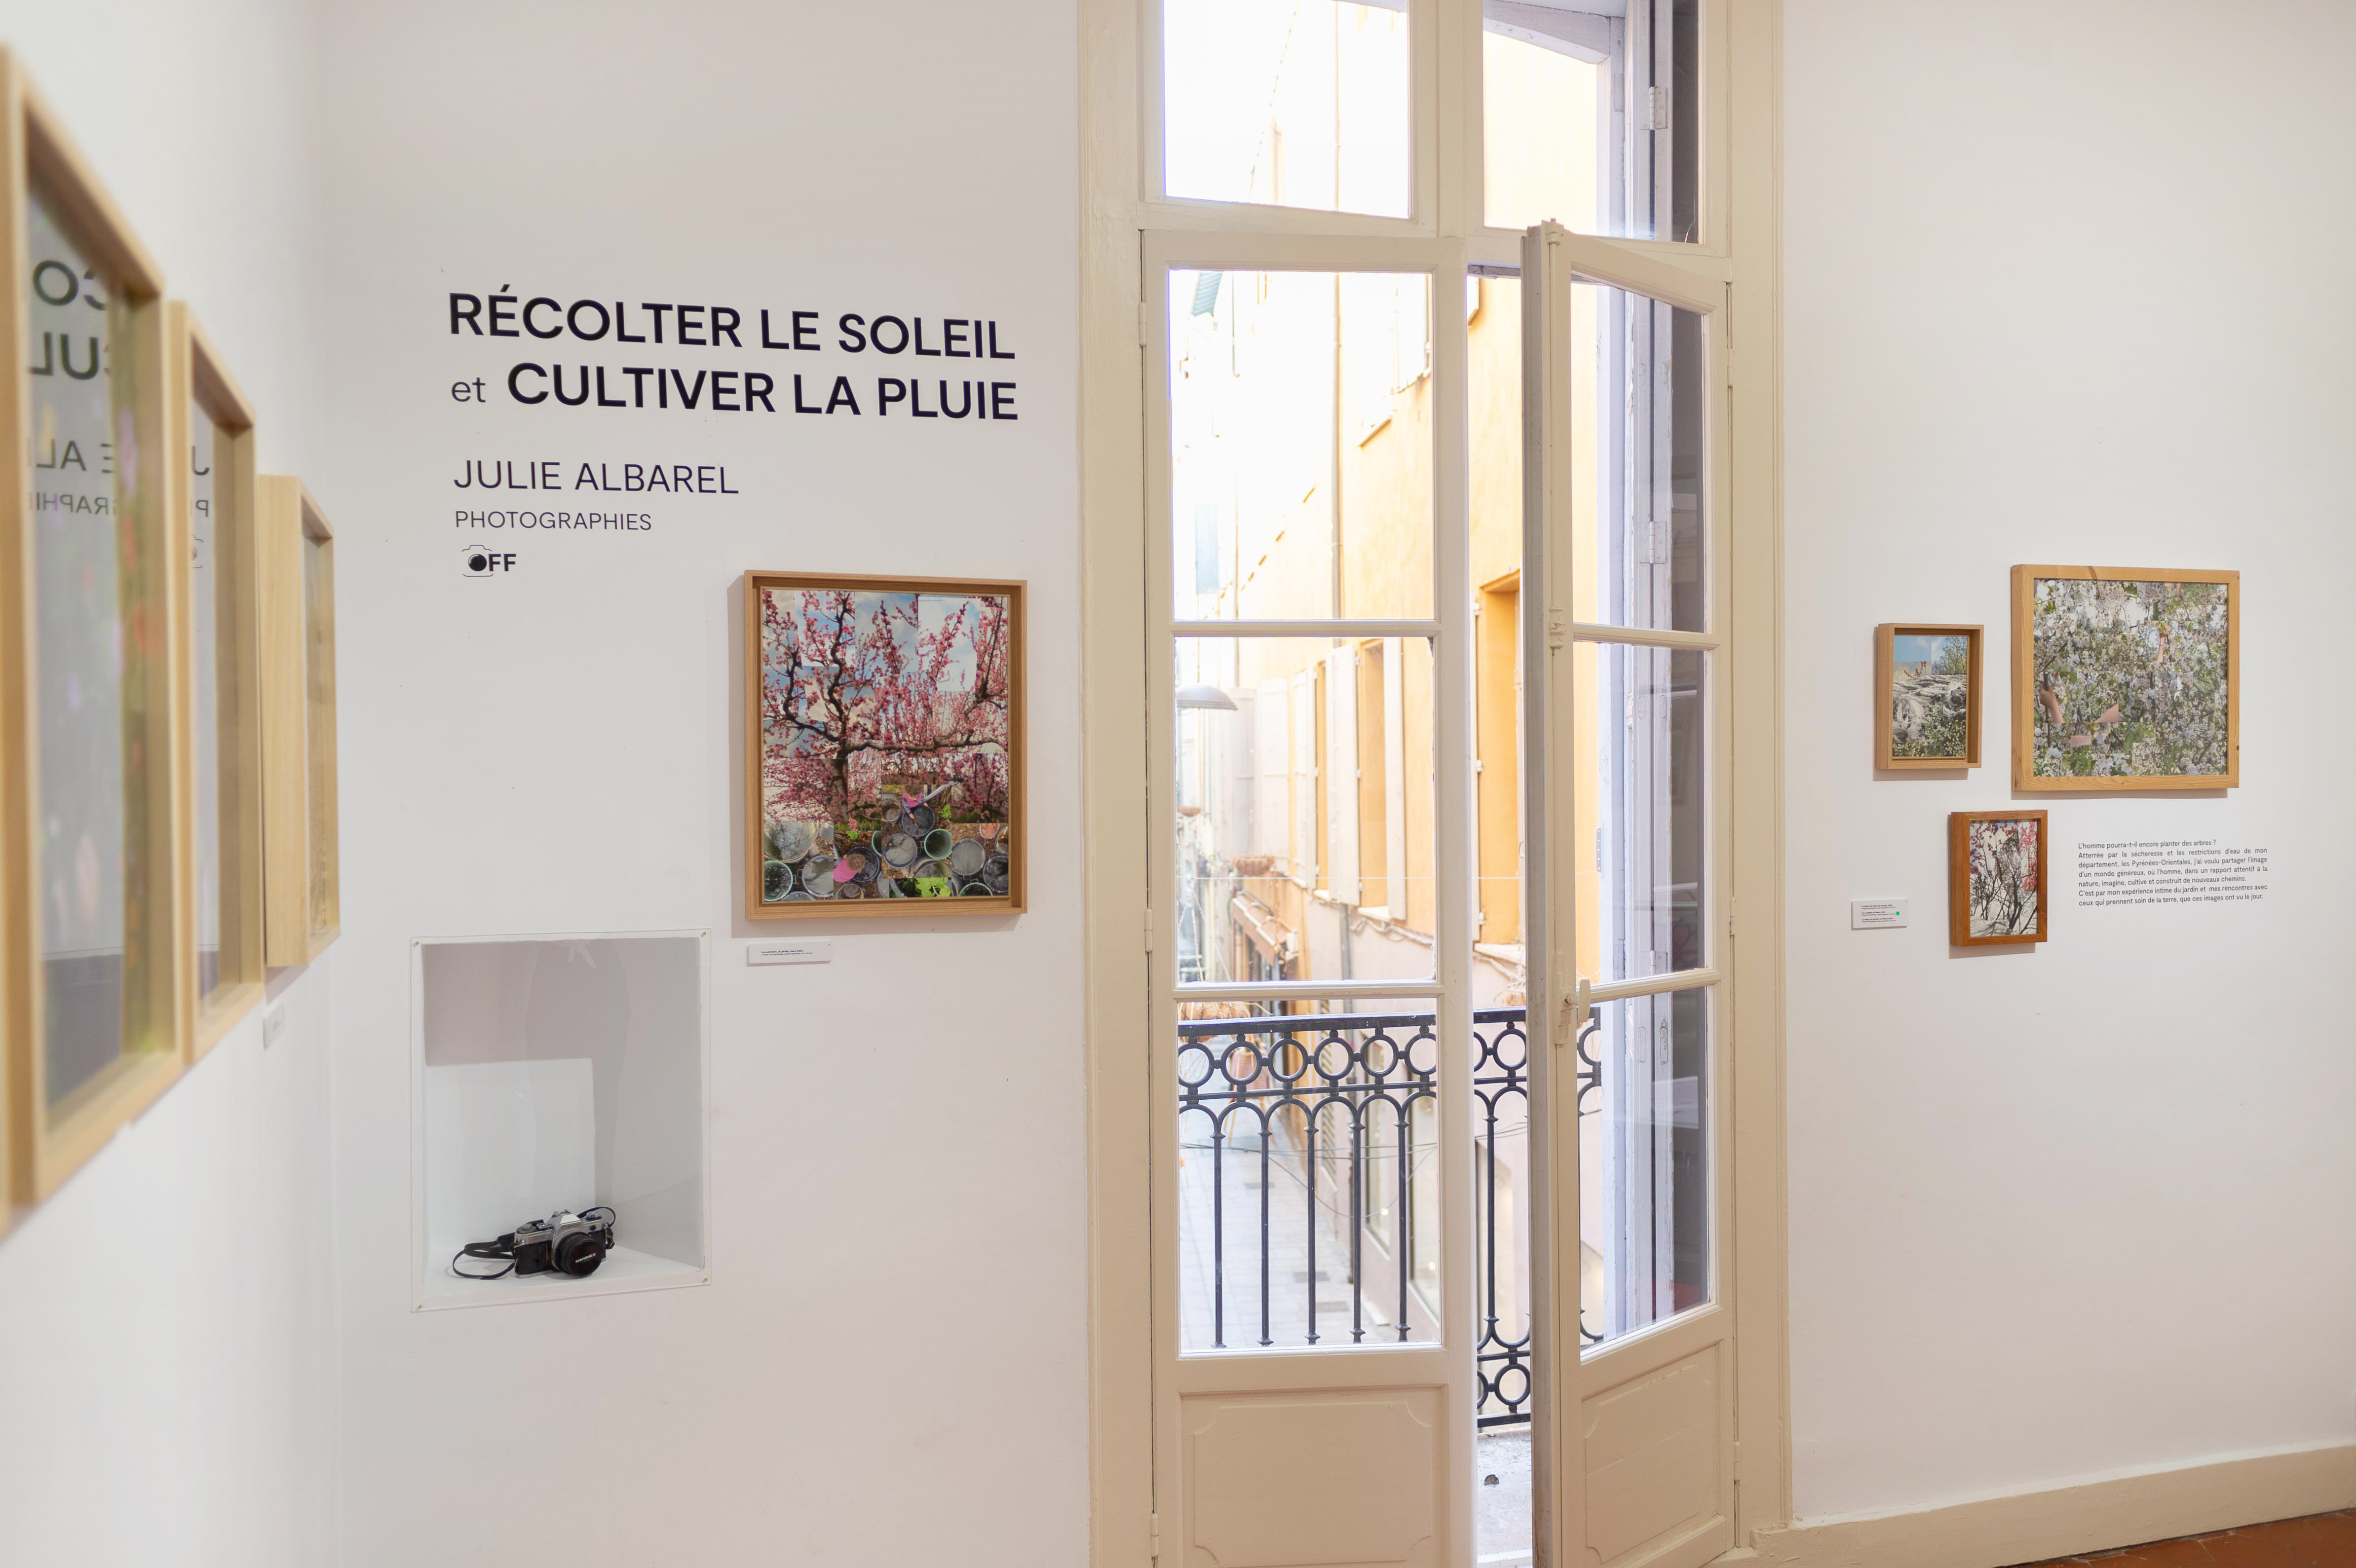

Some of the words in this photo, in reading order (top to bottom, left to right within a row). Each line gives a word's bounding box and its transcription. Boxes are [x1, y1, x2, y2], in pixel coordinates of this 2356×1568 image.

[450, 284, 742, 347] RÉCOLTER
[761, 309, 820, 351] LE
[839, 314, 1015, 359] SOLEIL
[452, 377, 485, 403] et
[508, 363, 775, 412] CULTIVER
[794, 374, 861, 415] LA
[878, 378, 1018, 420] PLUIE
[454, 460, 561, 489] JULIE
[575, 463, 738, 493] ALBAREL
[456, 511, 651, 530] PHOTOGRAPHIES
